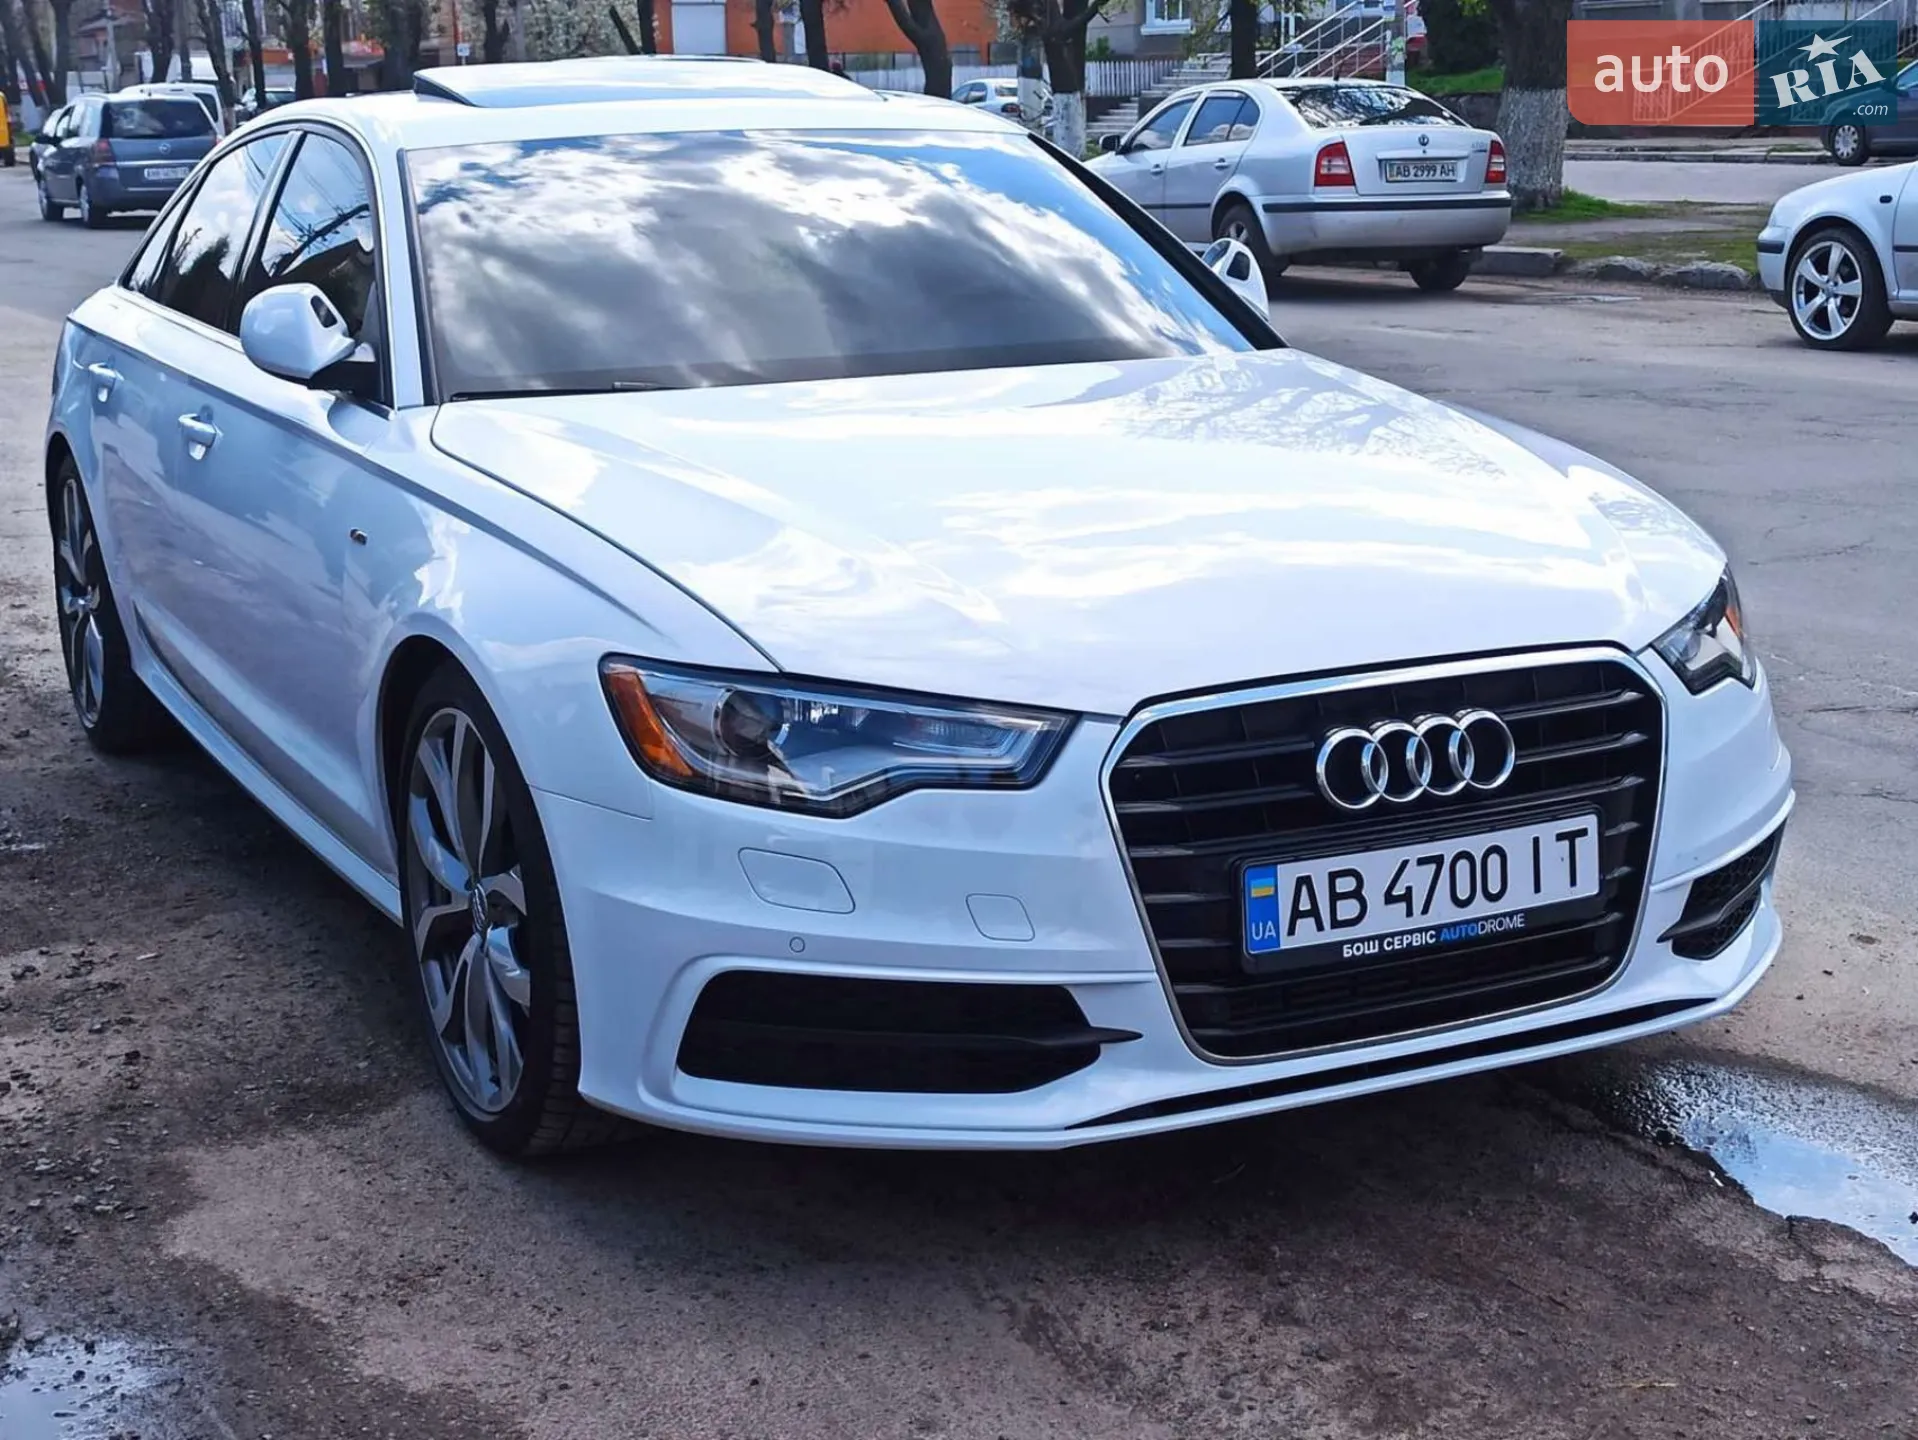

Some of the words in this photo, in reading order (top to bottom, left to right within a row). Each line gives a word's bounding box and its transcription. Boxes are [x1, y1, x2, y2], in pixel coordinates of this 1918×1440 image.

[1396, 164, 1411, 178] AB
[1287, 867, 1369, 937] AB
[1383, 844, 1508, 918] 4700
[1532, 827, 1589, 895] IT
[1251, 921, 1277, 940] UA
[1343, 940, 1379, 958] БОШ
[1383, 930, 1436, 951] СЕРВІС
[1440, 913, 1526, 942] AUTODROME
